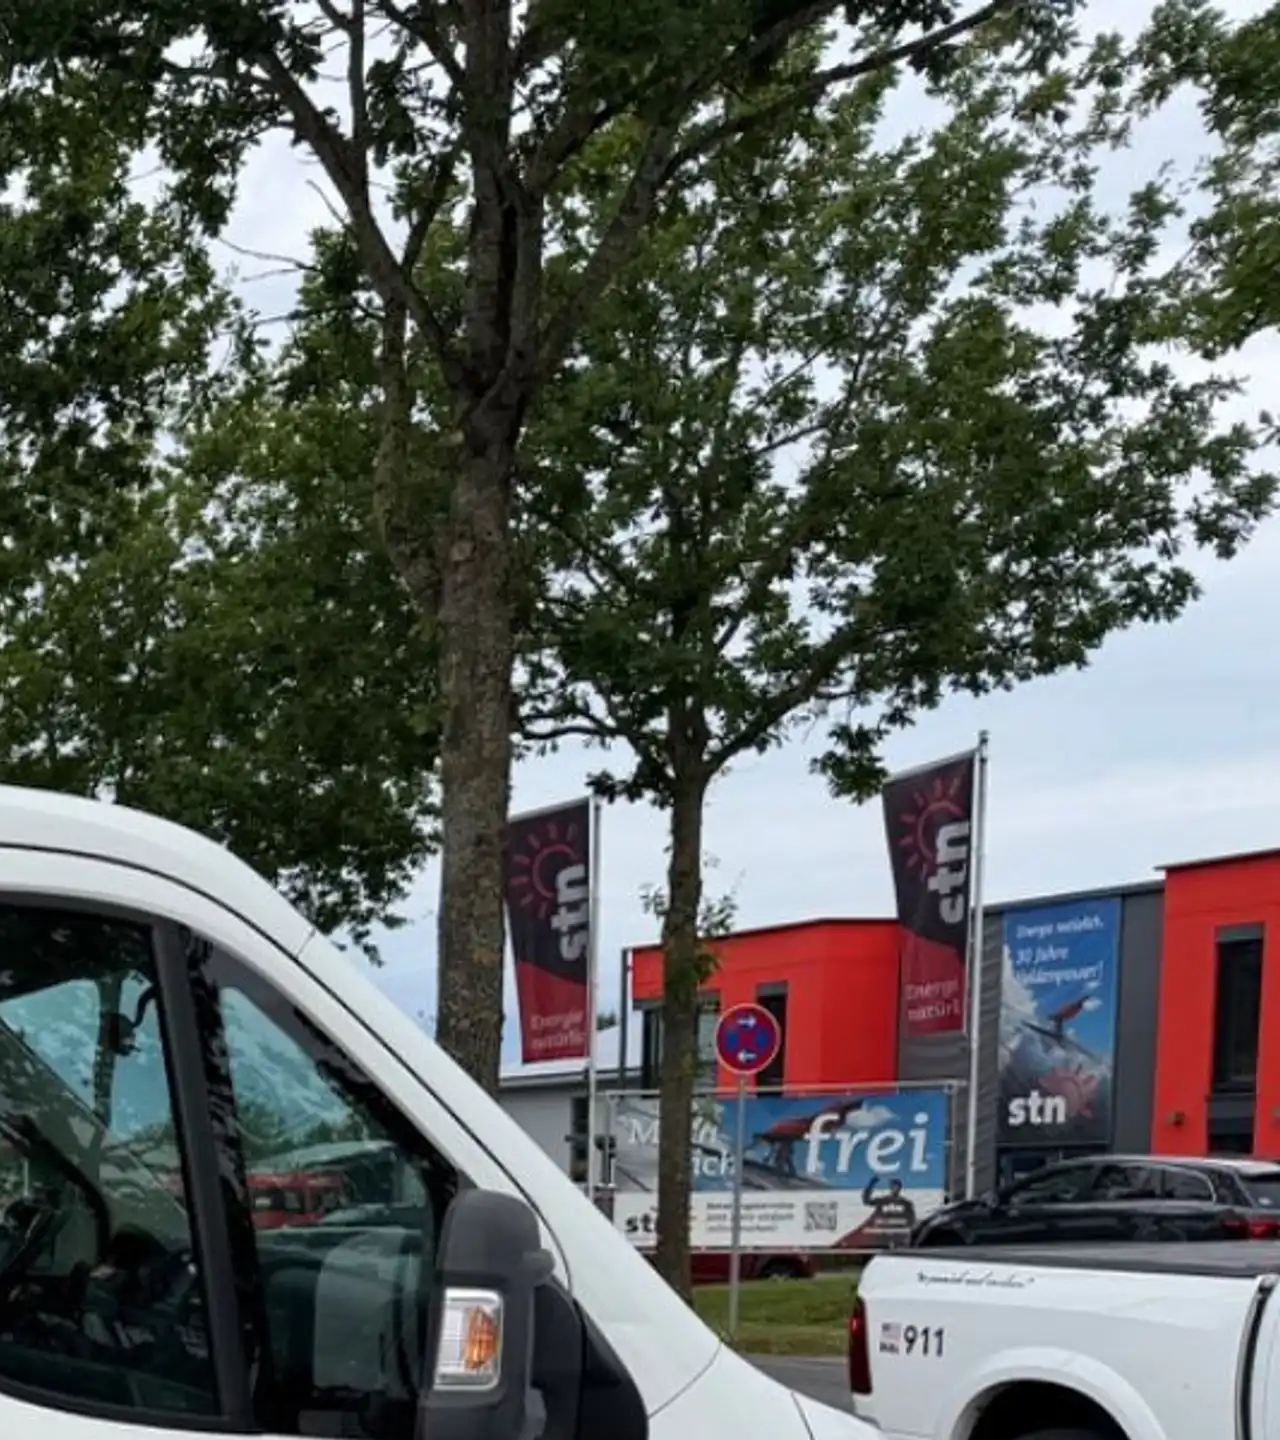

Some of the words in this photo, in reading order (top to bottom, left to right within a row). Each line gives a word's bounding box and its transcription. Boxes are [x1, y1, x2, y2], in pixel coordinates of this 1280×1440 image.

[551, 863, 590, 961] stn
[1007, 1089, 1066, 1126] stn
[804, 1111, 929, 1174] frei
[903, 1324, 945, 1358] 911
